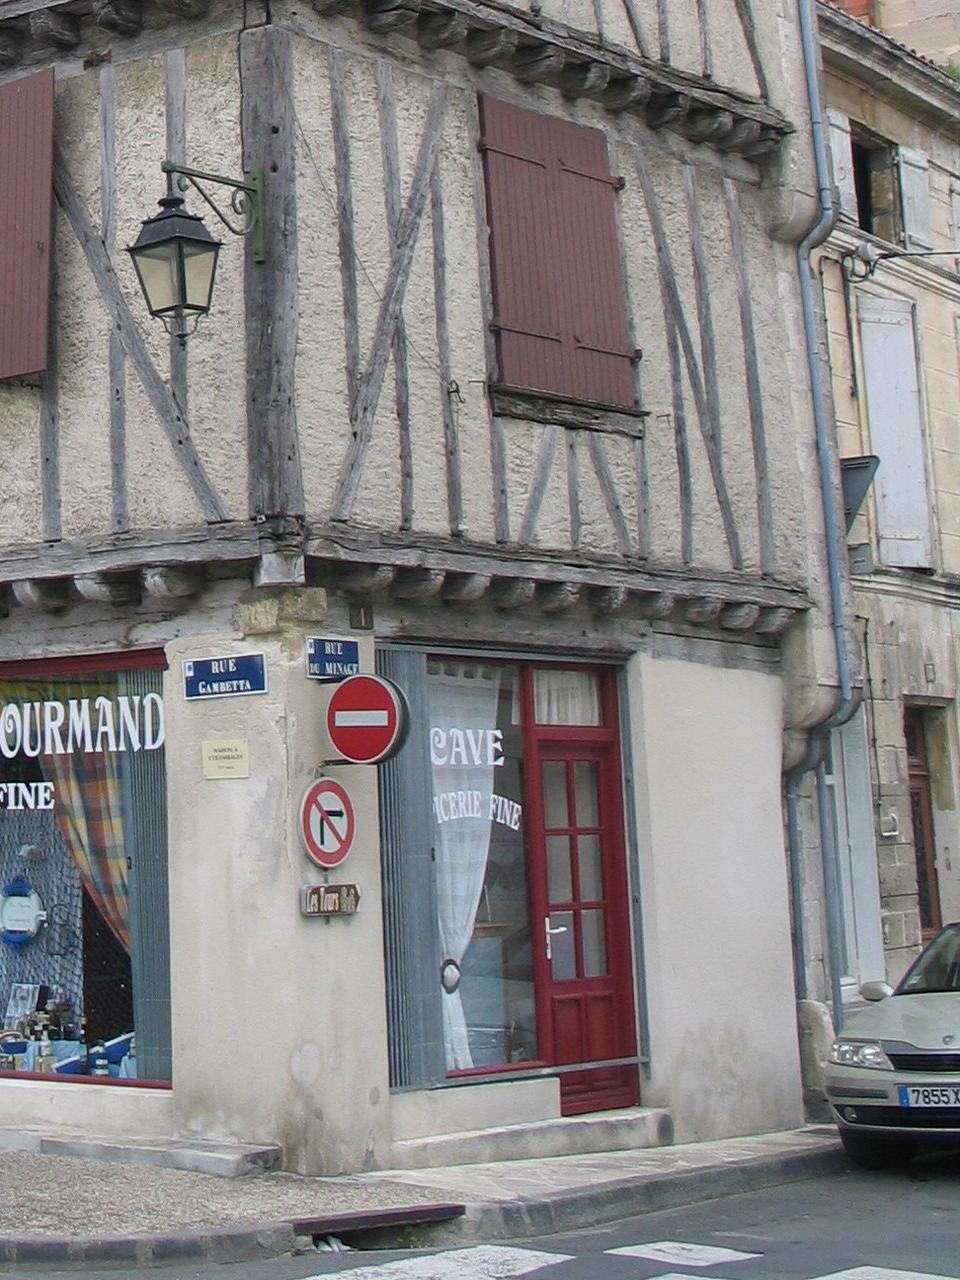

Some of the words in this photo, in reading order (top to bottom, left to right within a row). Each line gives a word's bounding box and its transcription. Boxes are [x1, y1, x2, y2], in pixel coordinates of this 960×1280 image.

[324, 641, 343, 656] RUE
[211, 658, 237, 674] RUE
[309, 662, 320, 675] DU
[325, 662, 359, 676] MINAGE
[198, 679, 252, 694] GAMBETTA
[429, 727, 505, 767] CAVE
[432, 790, 482, 824] ICERIE
[488, 793, 522, 831] FINE
[306, 890, 318, 912] Les
[320, 887, 339, 912] Tours
[911, 1088, 951, 1105] 7855
